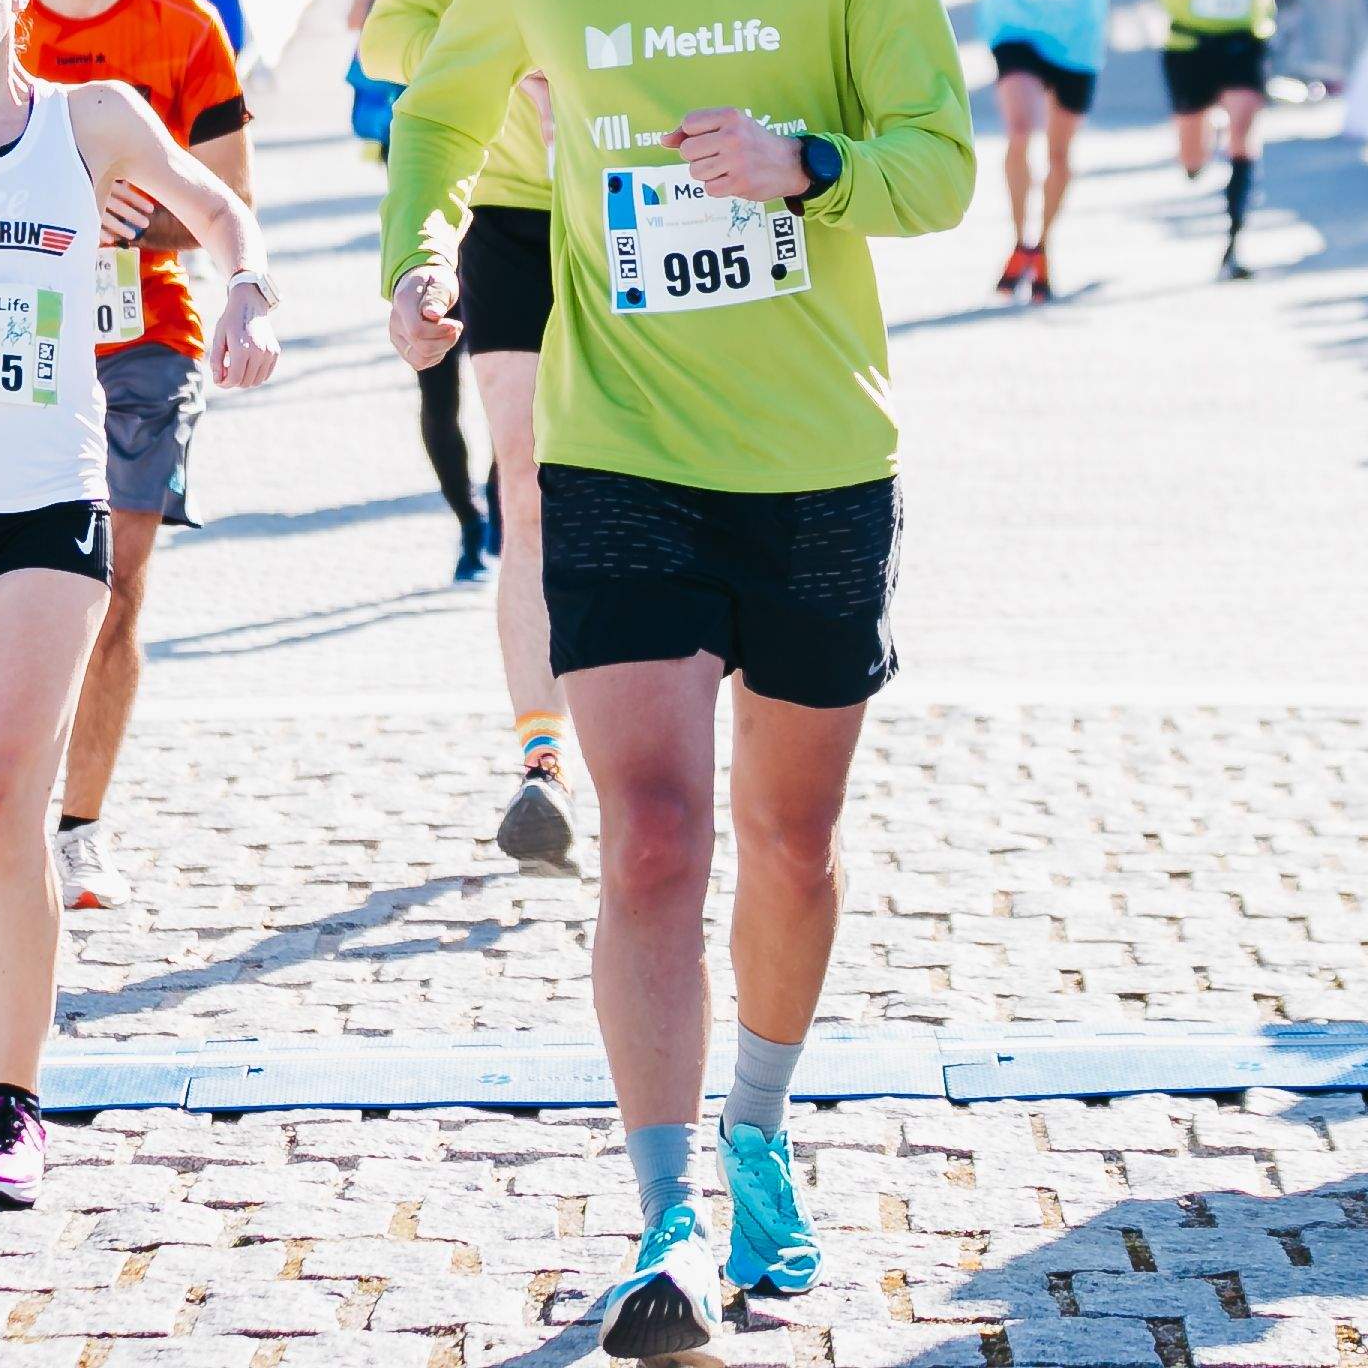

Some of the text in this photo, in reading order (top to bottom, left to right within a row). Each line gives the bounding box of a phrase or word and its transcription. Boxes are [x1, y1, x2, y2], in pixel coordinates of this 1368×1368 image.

[644, 19, 781, 58] MetLife
[634, 132, 667, 147] 15K
[0, 220, 43, 245] RUN
[663, 244, 751, 298] 995
[97, 304, 113, 334] 0
